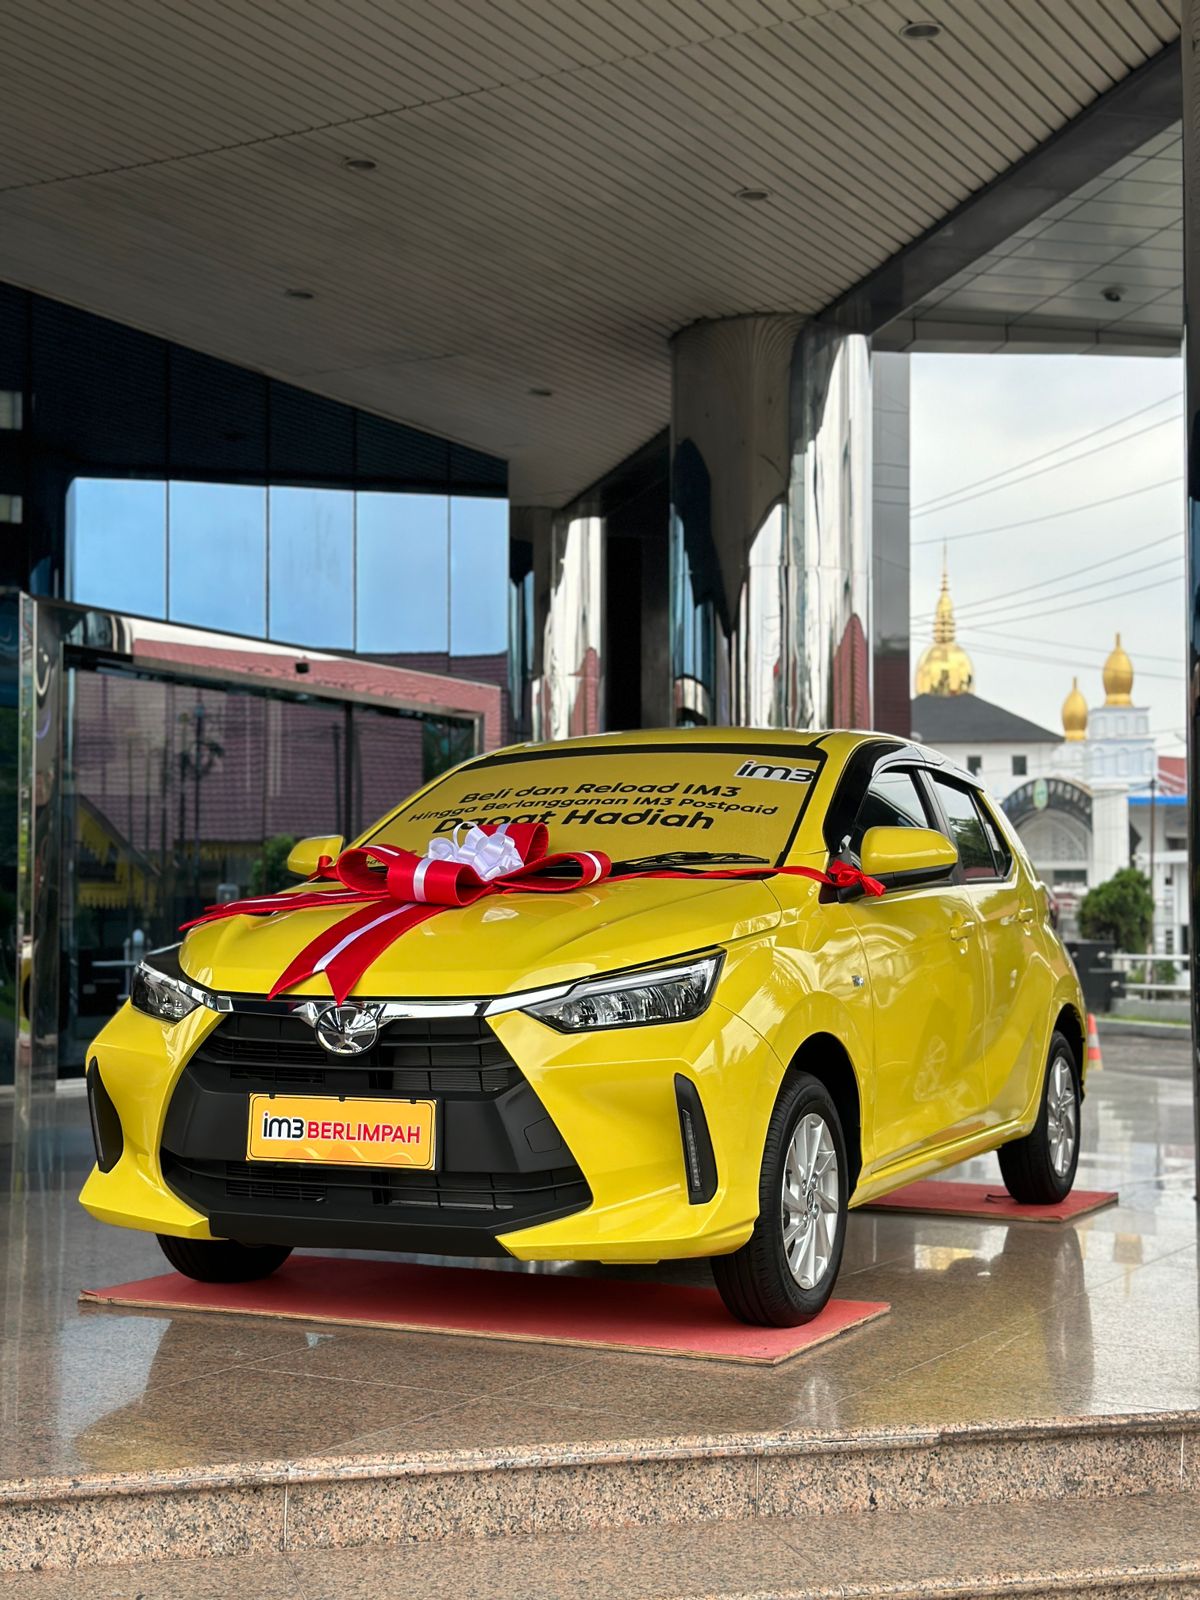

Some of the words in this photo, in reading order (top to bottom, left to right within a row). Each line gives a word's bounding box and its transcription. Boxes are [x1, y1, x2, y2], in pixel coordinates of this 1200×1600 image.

[736, 760, 816, 783] im3
[459, 787, 513, 804] Beli
[514, 785, 569, 797] dan
[574, 782, 680, 795] Reload
[682, 783, 742, 798] IM3
[408, 805, 478, 822] Hingga
[481, 797, 629, 812] Berlangganan
[632, 796, 675, 807] IM3
[678, 798, 779, 815] Postpaid
[561, 808, 715, 831] Hadiah
[262, 1112, 305, 1139] im3
[307, 1121, 421, 1143] BERLIMPAH
